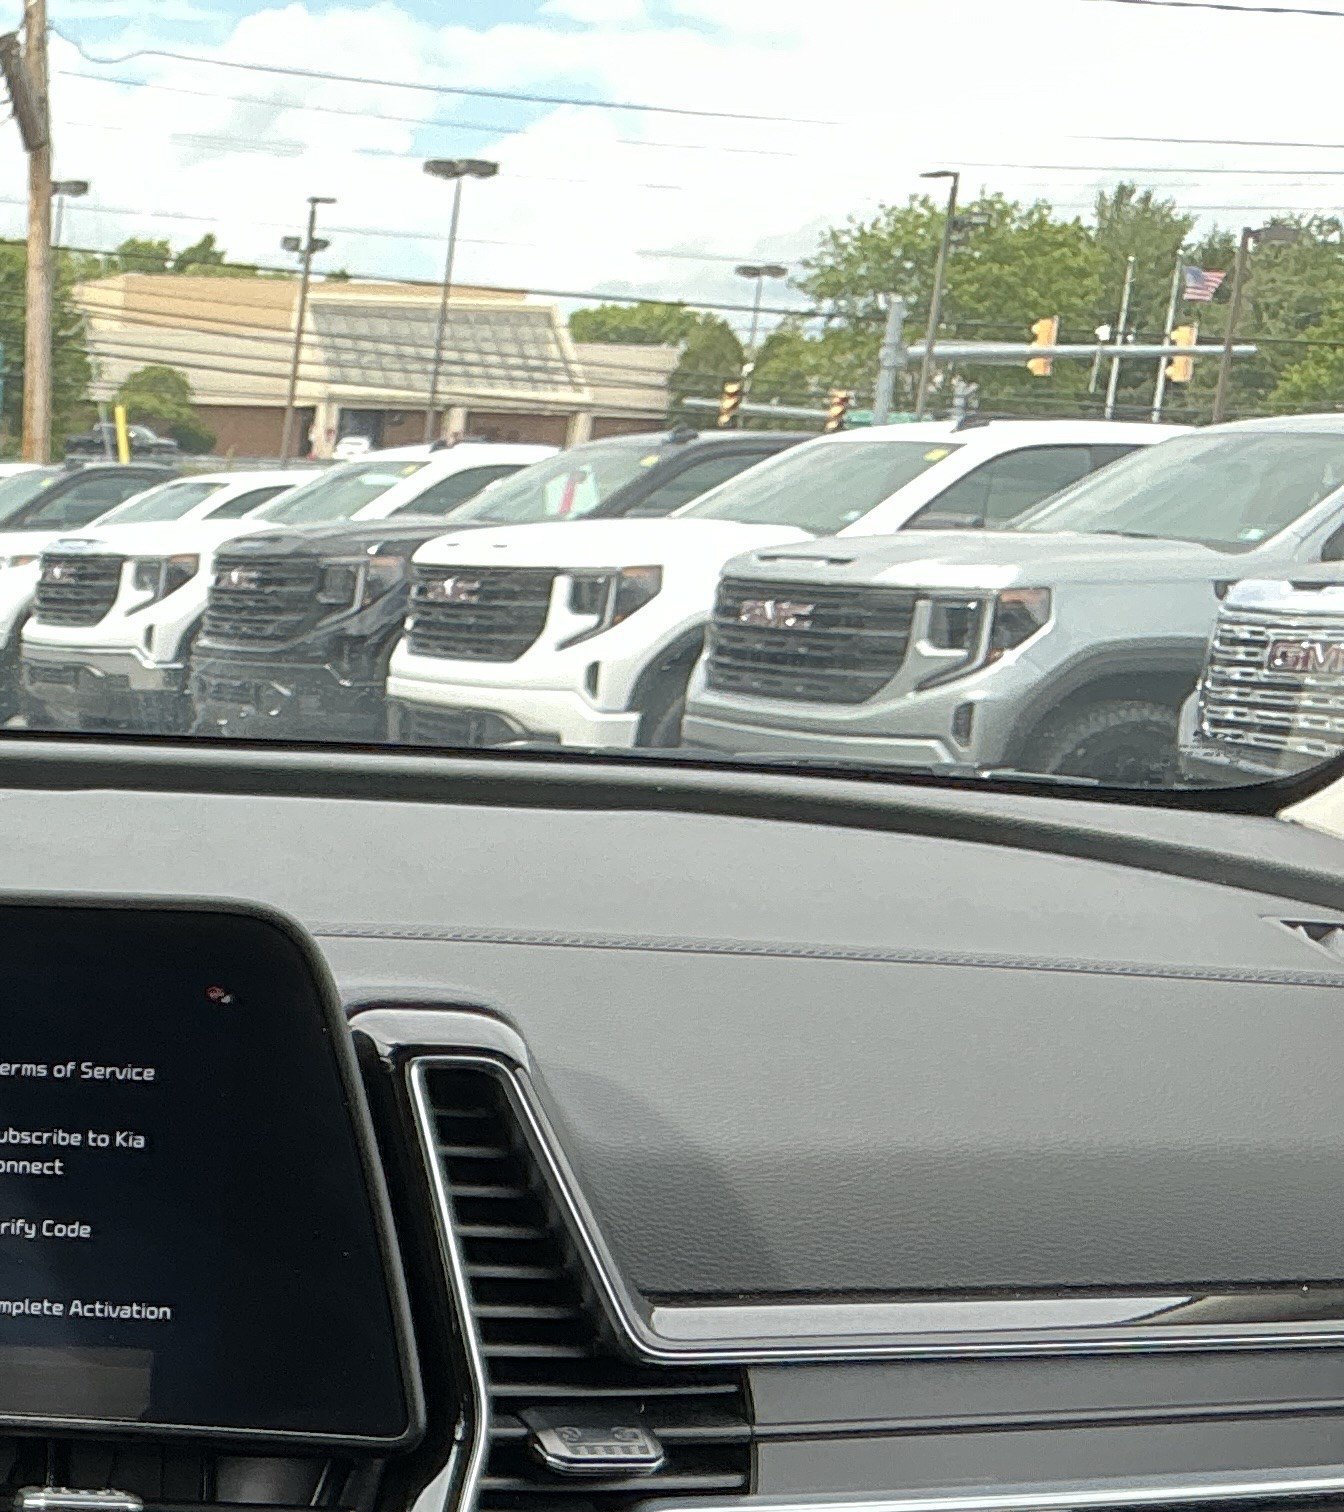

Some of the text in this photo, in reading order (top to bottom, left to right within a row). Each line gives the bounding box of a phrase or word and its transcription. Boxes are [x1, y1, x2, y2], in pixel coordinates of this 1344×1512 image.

[1266, 639, 1344, 673] GM
[52, 1061, 77, 1079] of
[80, 1061, 156, 1081] Service
[87, 1129, 110, 1148] to
[115, 1130, 146, 1149] Kia
[41, 1219, 92, 1238] Code
[68, 1299, 172, 1320] Activation
